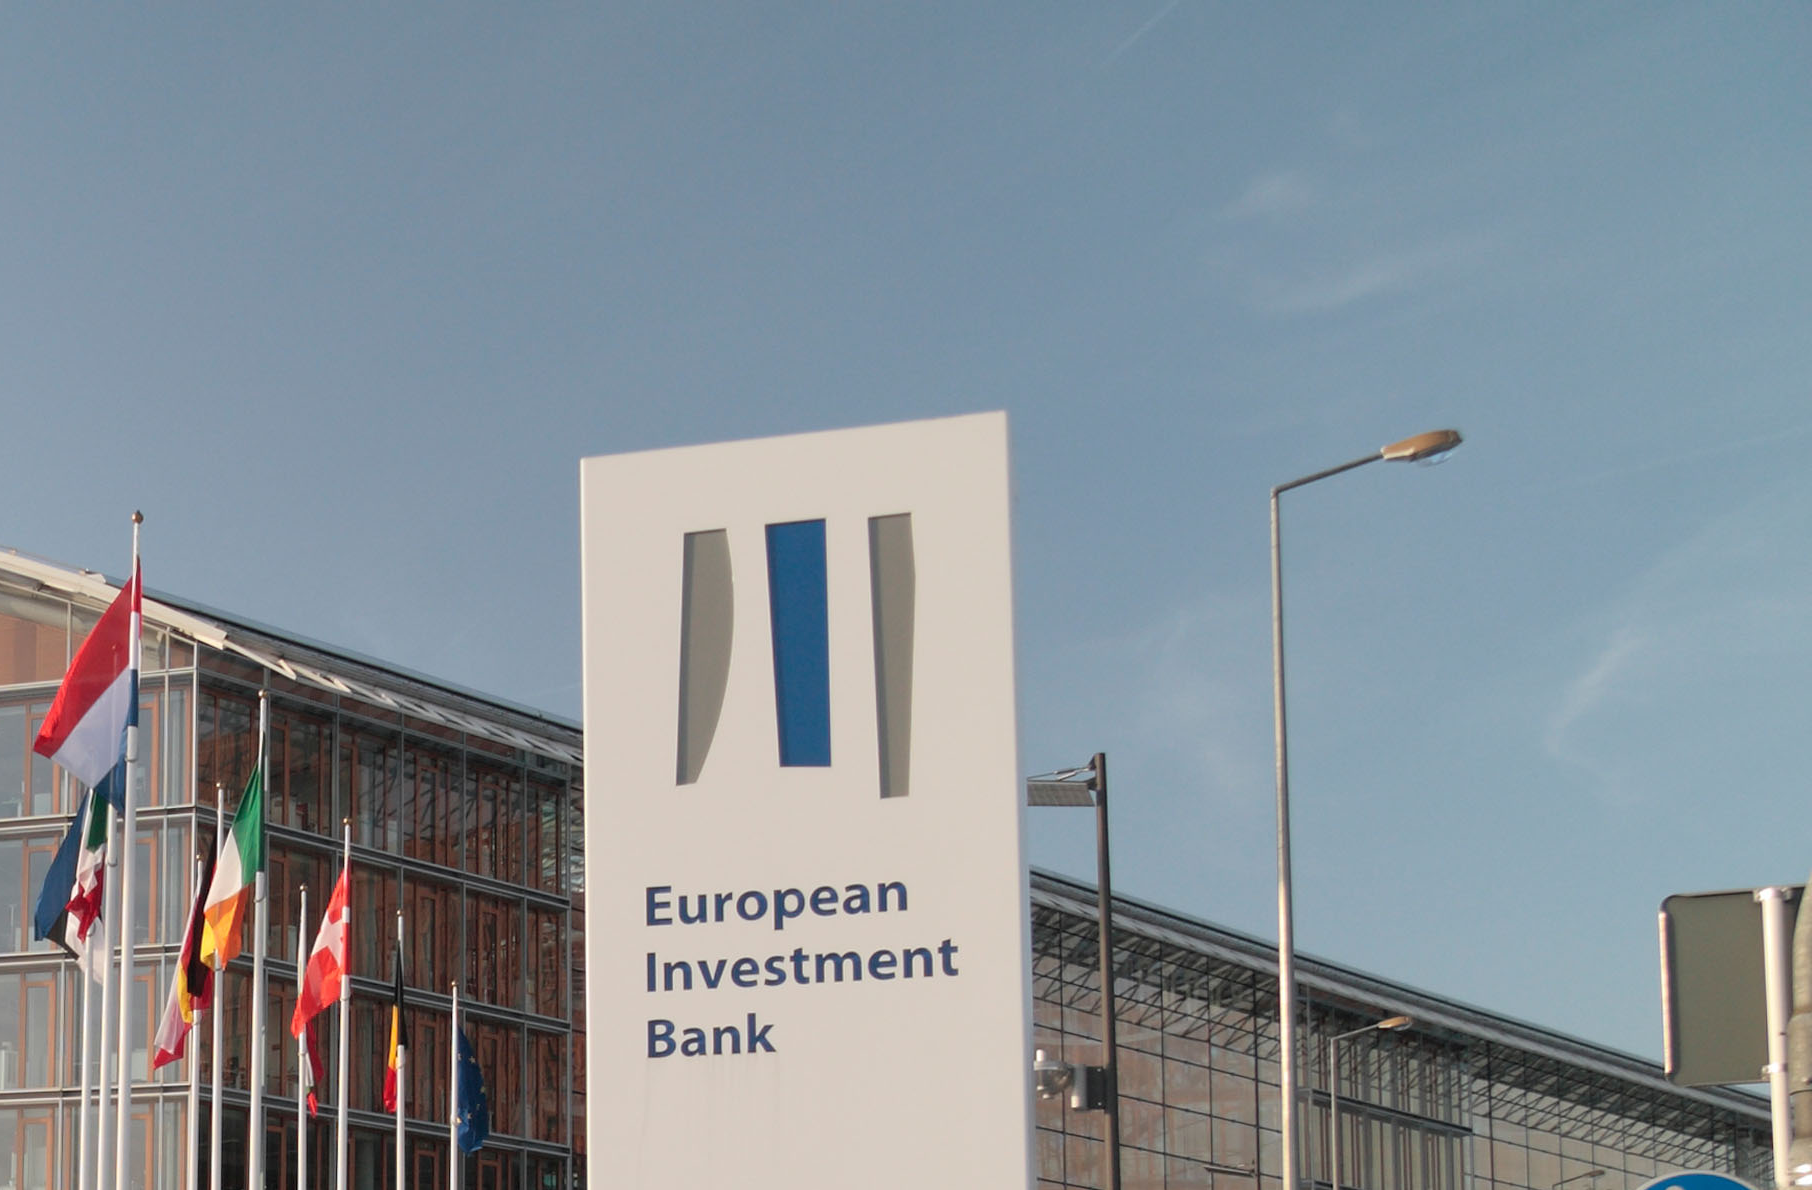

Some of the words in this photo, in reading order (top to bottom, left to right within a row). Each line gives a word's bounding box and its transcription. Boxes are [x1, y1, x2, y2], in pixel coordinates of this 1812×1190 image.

[645, 880, 908, 931] European
[646, 938, 960, 993] Investment
[647, 1012, 777, 1059] Bank
